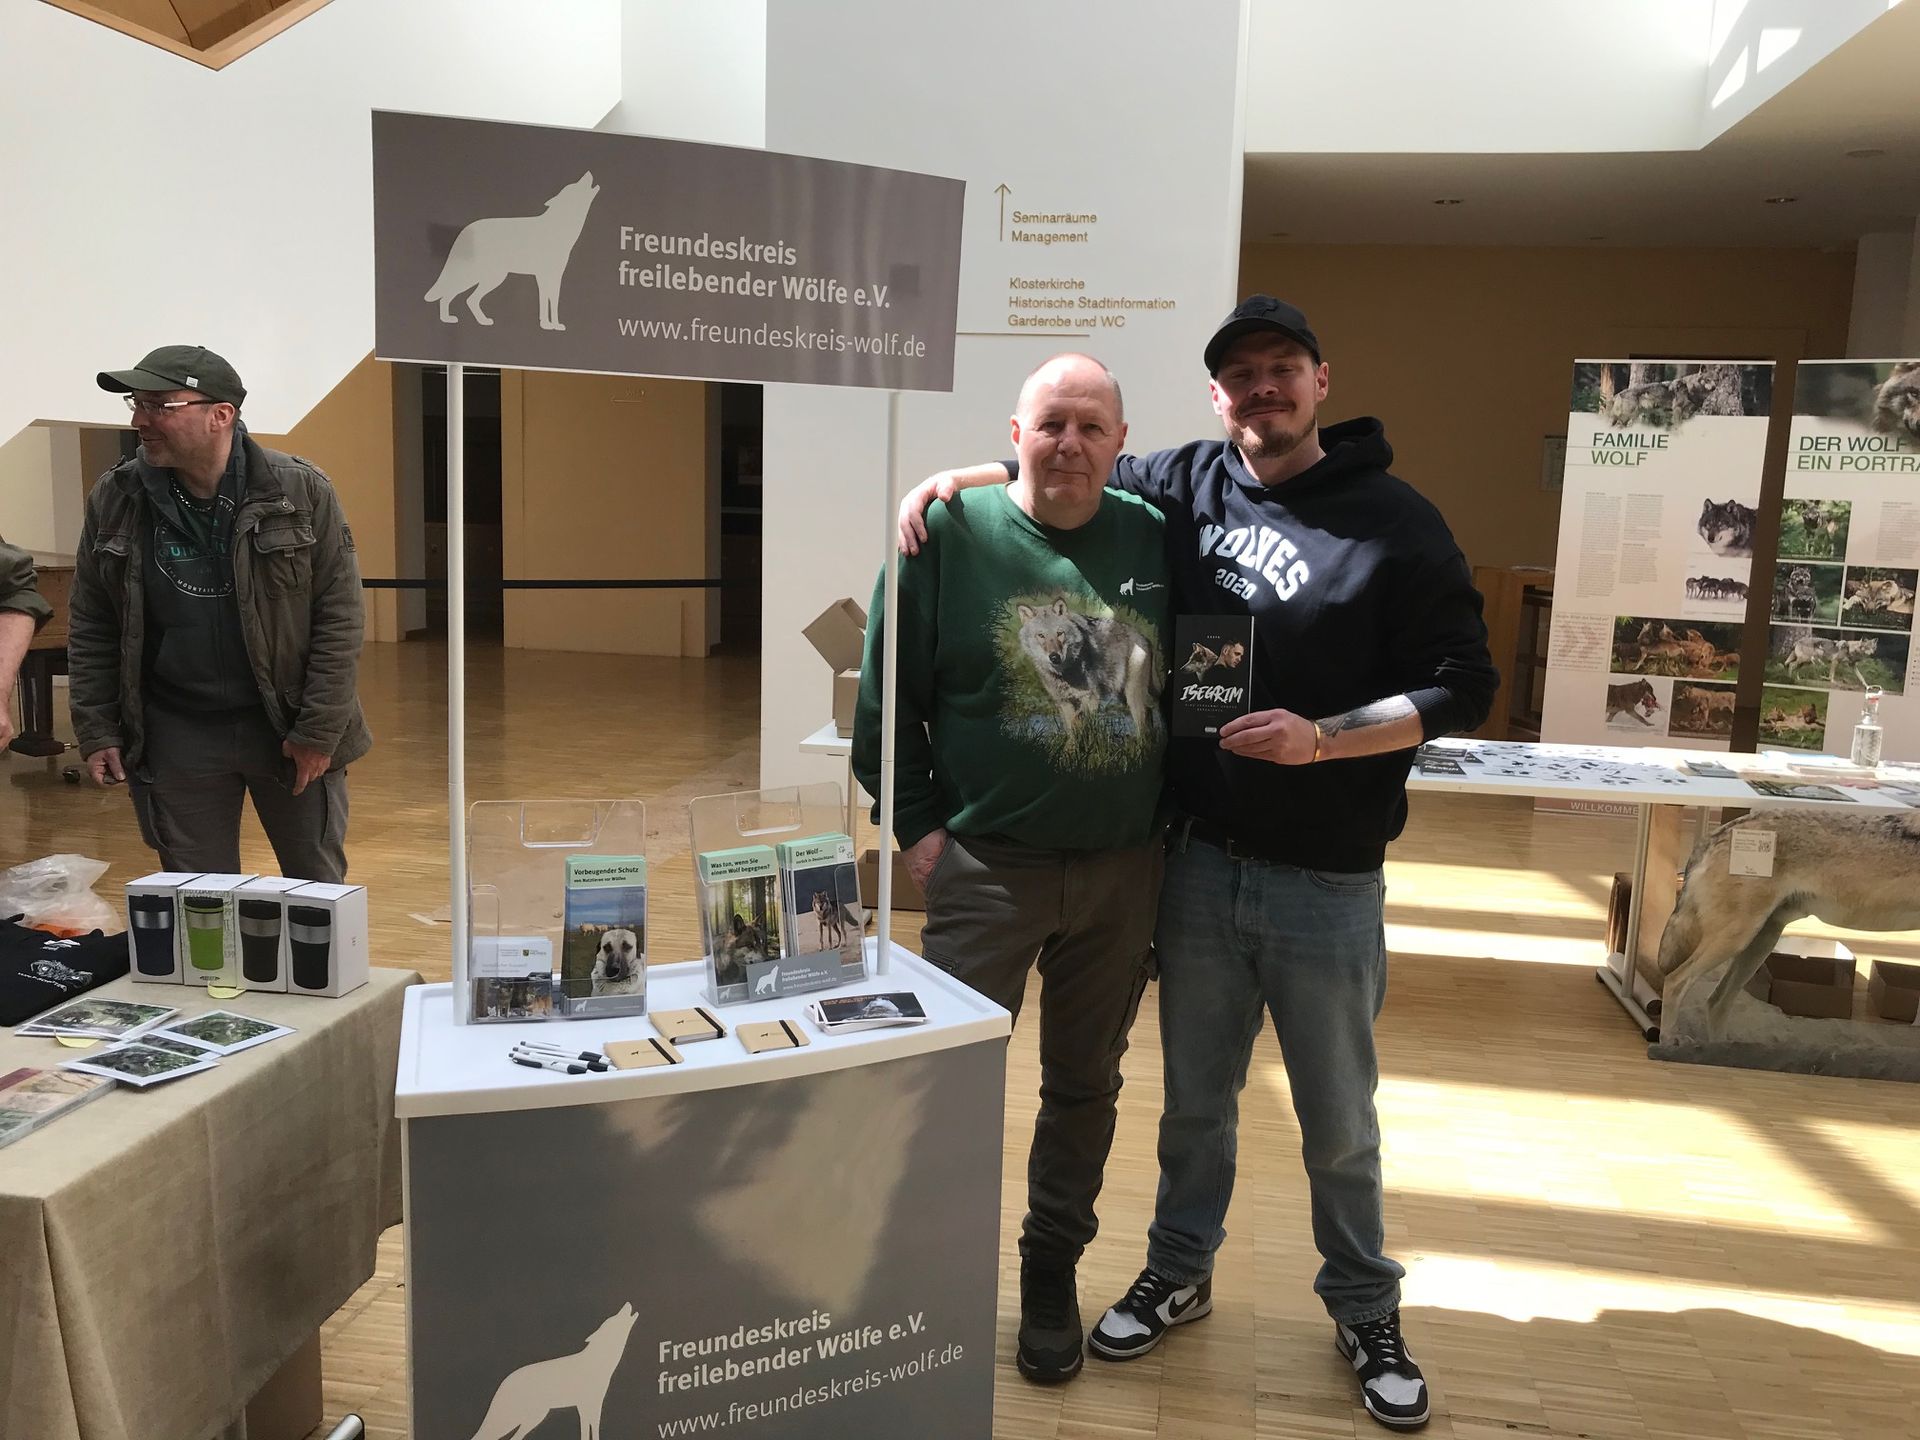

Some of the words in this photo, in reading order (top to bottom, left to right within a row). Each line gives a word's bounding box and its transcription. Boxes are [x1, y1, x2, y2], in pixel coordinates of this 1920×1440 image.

[1012, 211, 1097, 224] Seminarräume
[619, 225, 798, 266] Freundeskreis
[1011, 230, 1088, 245] Management
[618, 261, 777, 298] freilebender
[782, 274, 848, 305] Wölfe
[853, 284, 891, 308] e.V.
[1009, 277, 1085, 290] Klosterkirche
[1009, 296, 1074, 309] Historische
[1078, 296, 1176, 310] Stadtinformation
[1008, 314, 1071, 327] Garderobe
[1075, 315, 1096, 327] und
[1100, 315, 1126, 328] WC
[618, 316, 927, 358] www.freundeskreis-wolf.de
[1592, 432, 1670, 449] FAMILIE
[1799, 436, 1842, 451] DER
[1848, 436, 1907, 452] WOLF
[1591, 450, 1649, 466] WOLF
[1797, 455, 1832, 471] EIN
[1199, 524, 1310, 602] WOLVES
[1214, 568, 1258, 600] 2020
[1180, 684, 1244, 704] ISEGRIM
[806, 848, 819, 856] Wolf
[574, 868, 617, 876] Vorbeugender
[741, 864, 770, 872] begegnen?
[658, 1309, 832, 1364] Freundeskreis
[657, 1343, 813, 1394] freilebender
[816, 1326, 883, 1360] Wölfe
[888, 1311, 927, 1341] e.V.
[657, 1342, 964, 1439] www.freundeskreis-wolf.de
